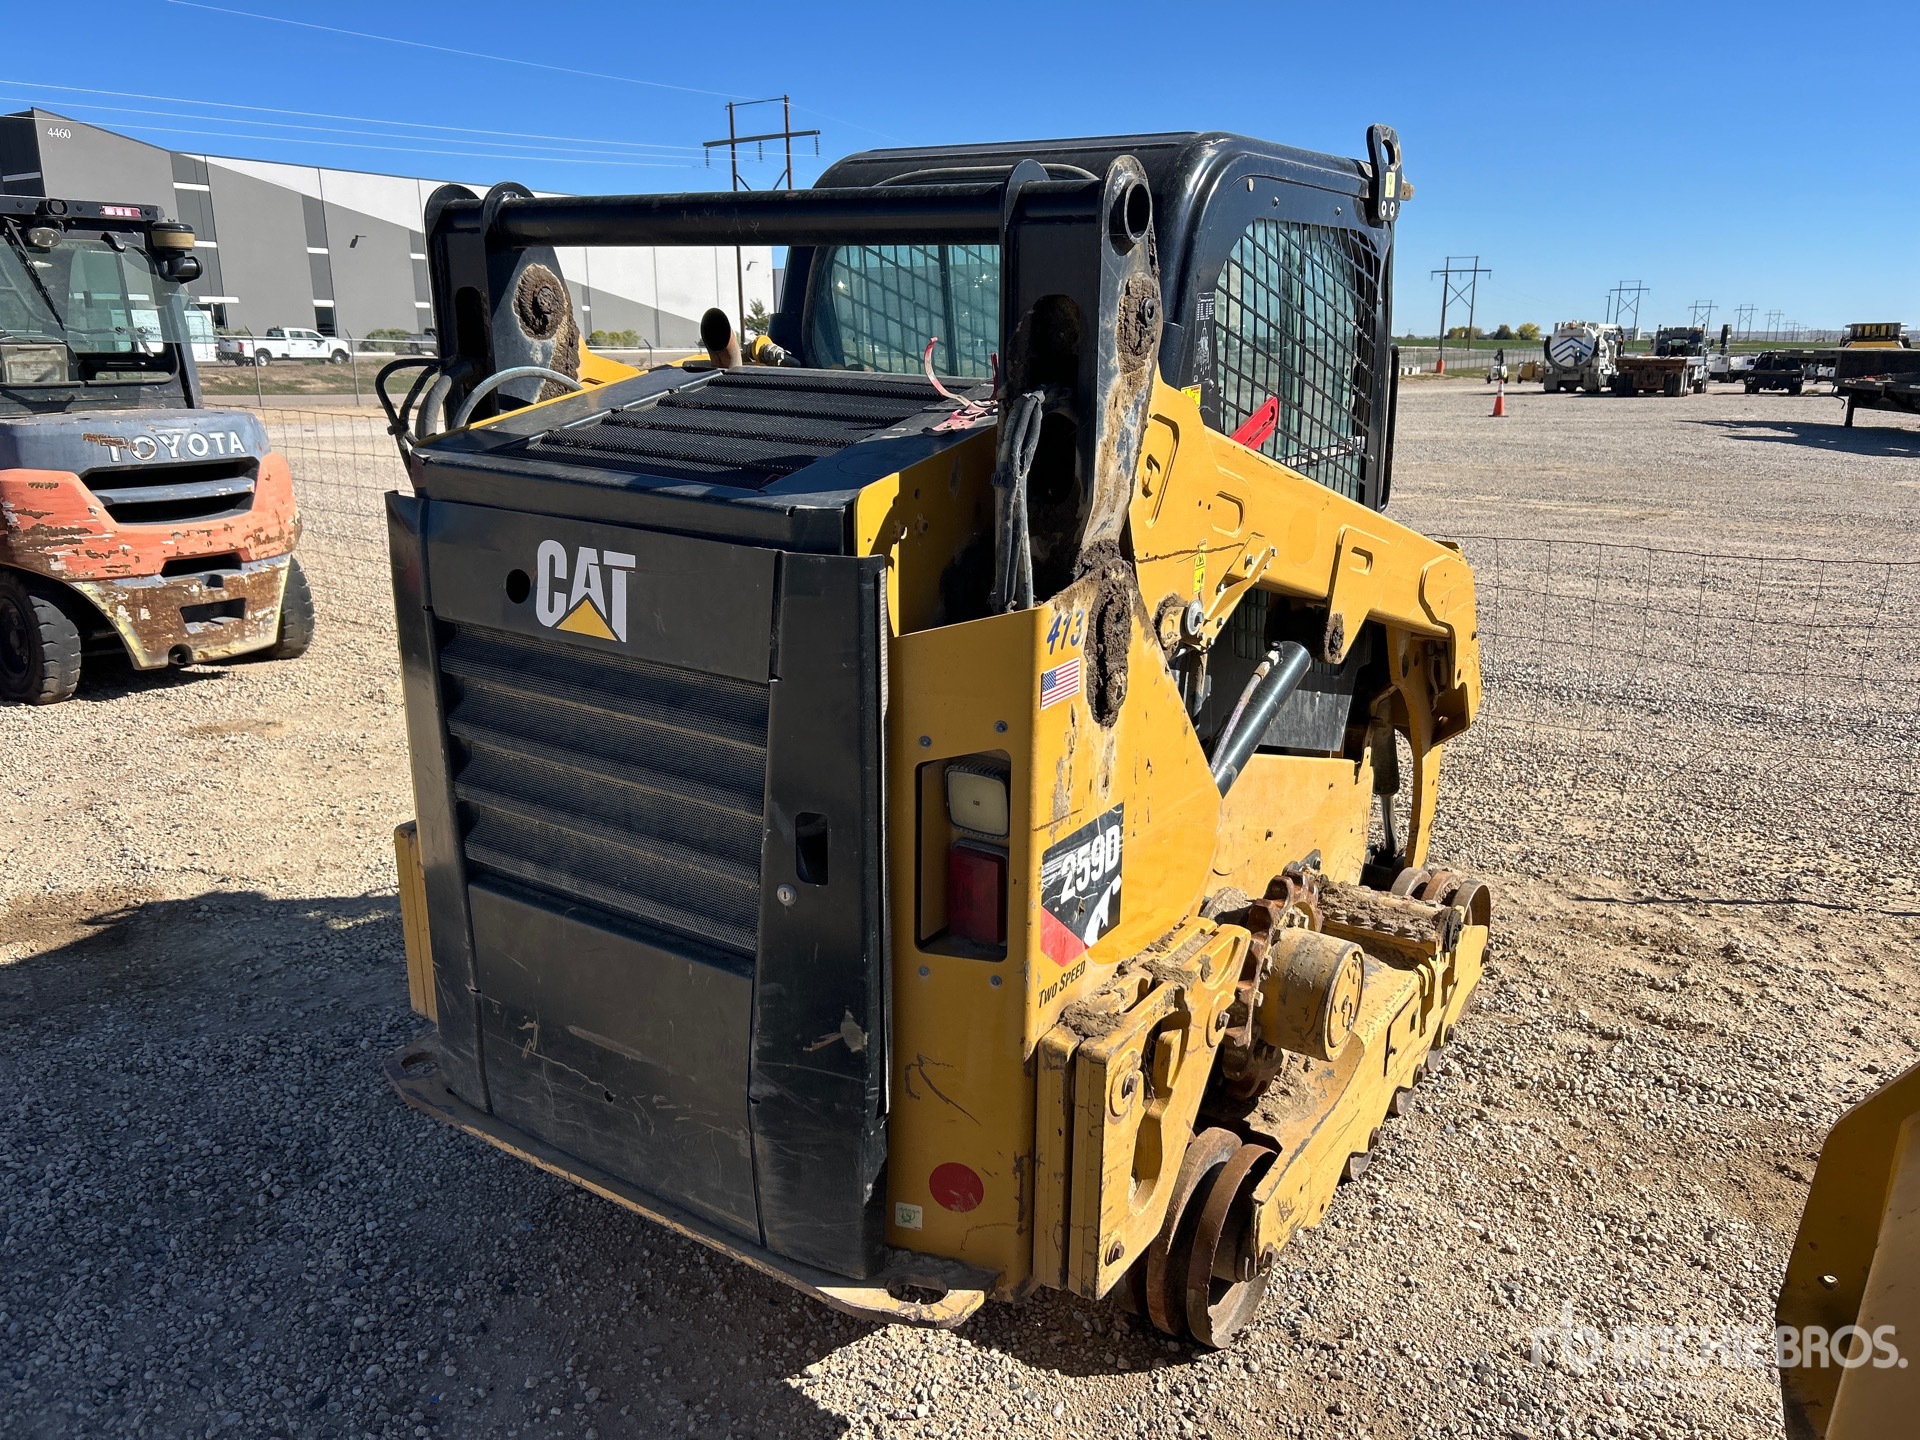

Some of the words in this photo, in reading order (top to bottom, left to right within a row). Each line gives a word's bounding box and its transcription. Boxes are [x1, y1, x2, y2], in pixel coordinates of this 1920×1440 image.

[47, 127, 72, 140] 4460
[100, 431, 246, 463] TOYOTA
[535, 539, 636, 643] CAT
[1046, 609, 1084, 655] 413
[1061, 824, 1120, 905] 259D
